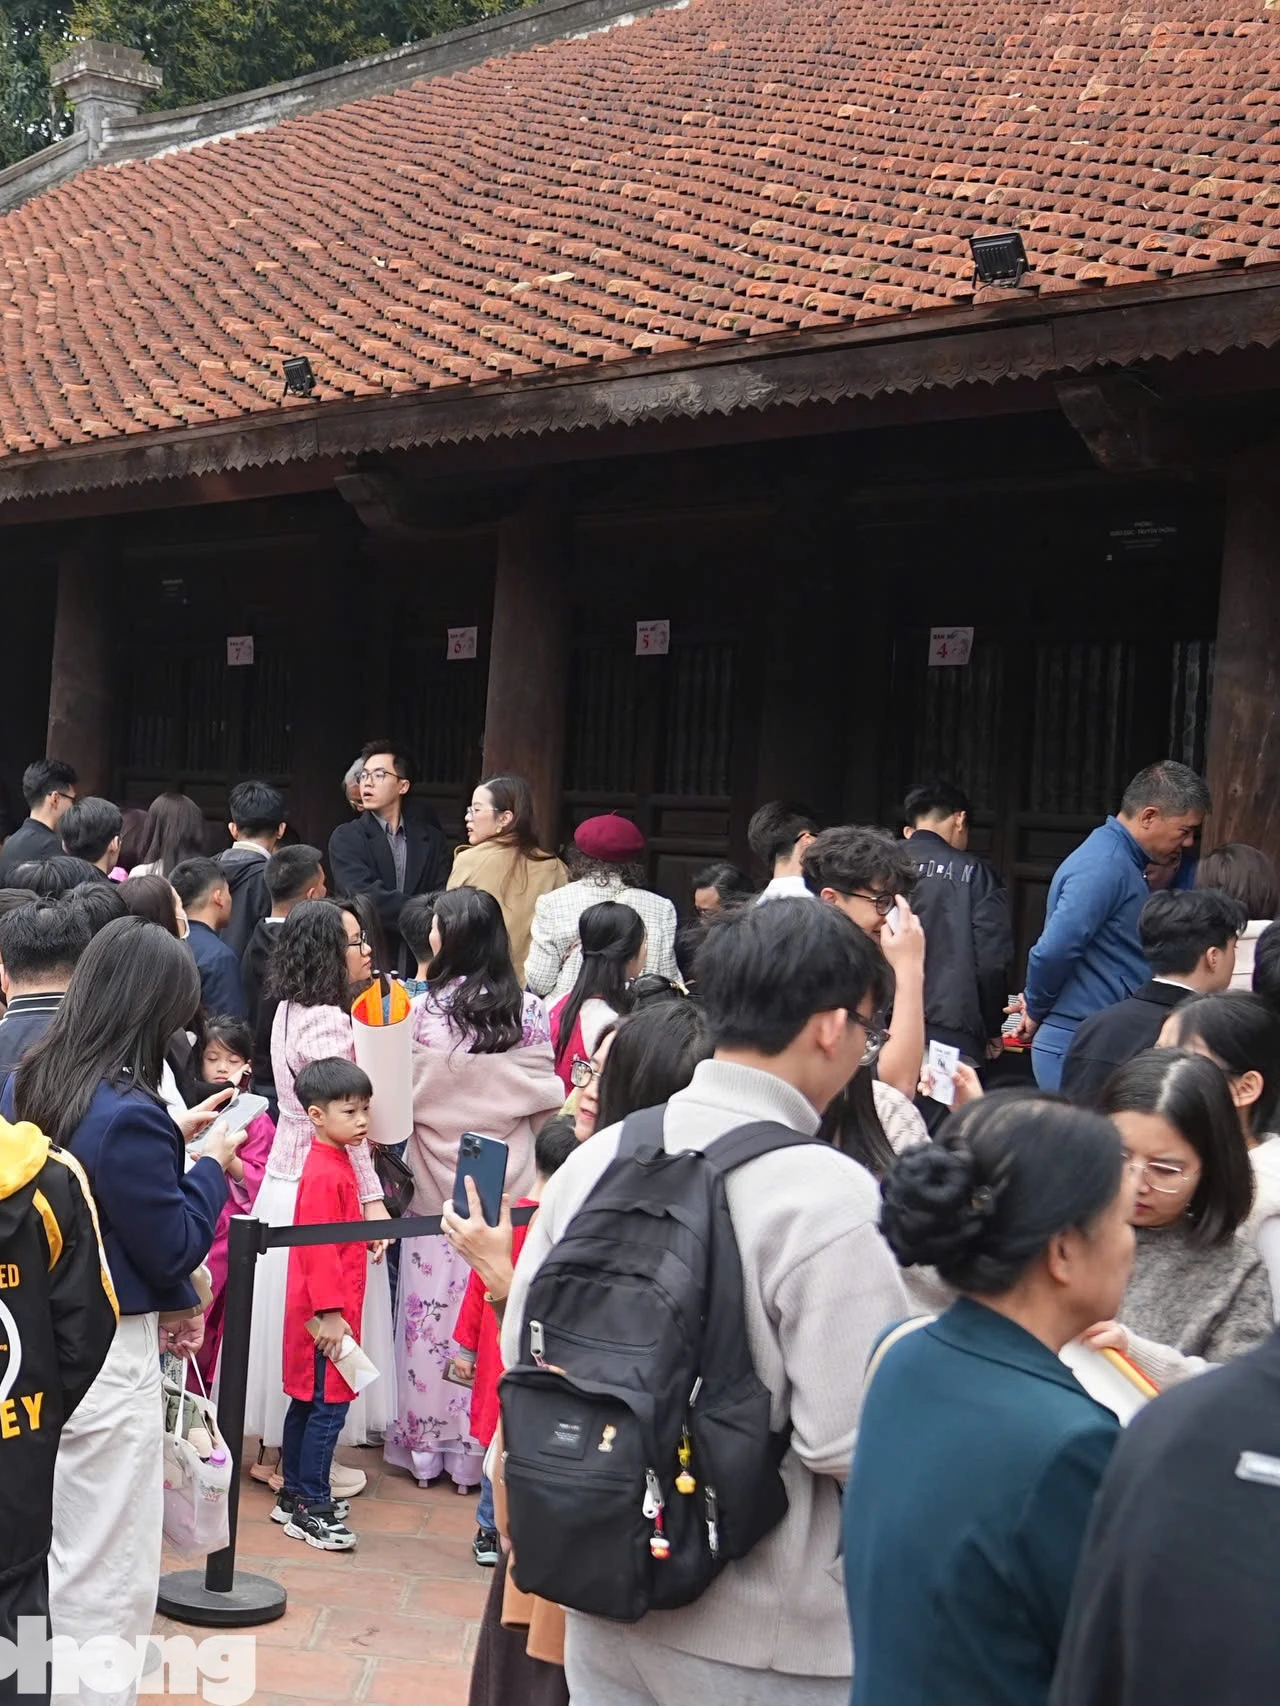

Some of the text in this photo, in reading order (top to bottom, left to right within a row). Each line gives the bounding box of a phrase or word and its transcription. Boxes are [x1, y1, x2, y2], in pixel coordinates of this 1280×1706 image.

[642, 634, 649, 649] 5
[235, 647, 241, 661] 7
[936, 642, 948, 658] 4
